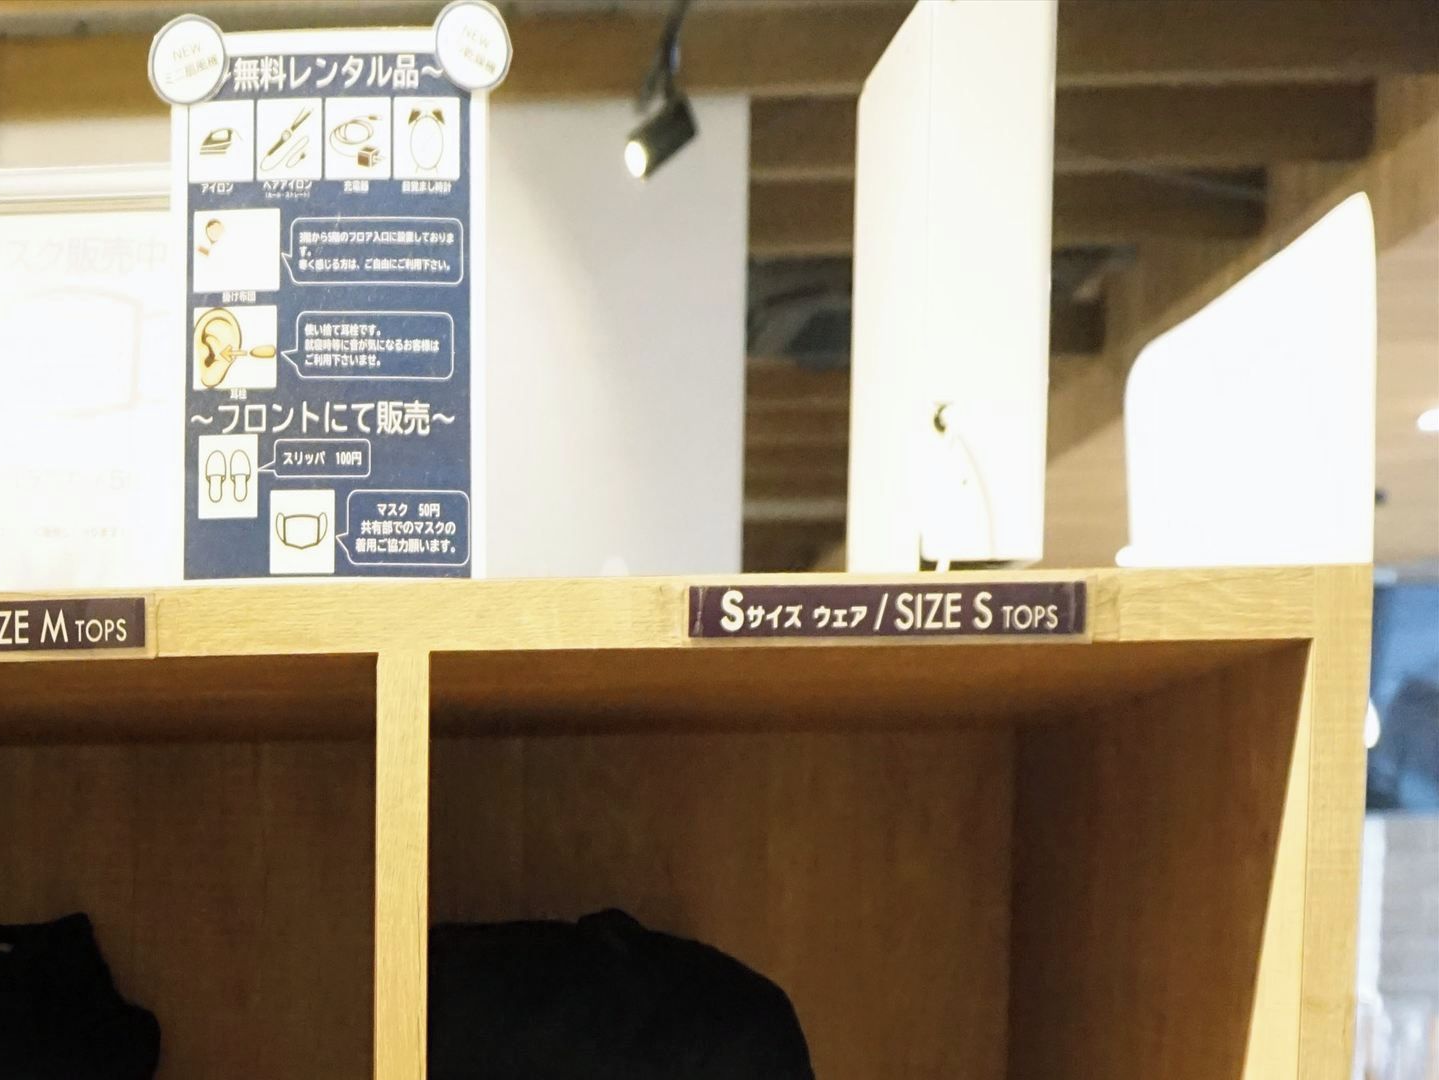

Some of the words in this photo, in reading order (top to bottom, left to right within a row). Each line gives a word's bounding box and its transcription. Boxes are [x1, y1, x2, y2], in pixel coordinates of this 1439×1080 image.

[201, 182, 234, 194] アイロン
[304, 353, 381, 367] ご利用下さいませ。
[282, 451, 326, 466] スリッパ
[335, 451, 362, 466] 100円
[377, 503, 408, 517] マスク
[418, 503, 440, 518] 50円
[361, 520, 456, 535] 共有部でのマスクの
[813, 604, 868, 628] ウェア
[894, 592, 962, 630] SIZE
[972, 591, 992, 630] S
[1002, 604, 1059, 630] TOPS
[40, 608, 69, 644] M
[75, 618, 127, 643] TOPS
